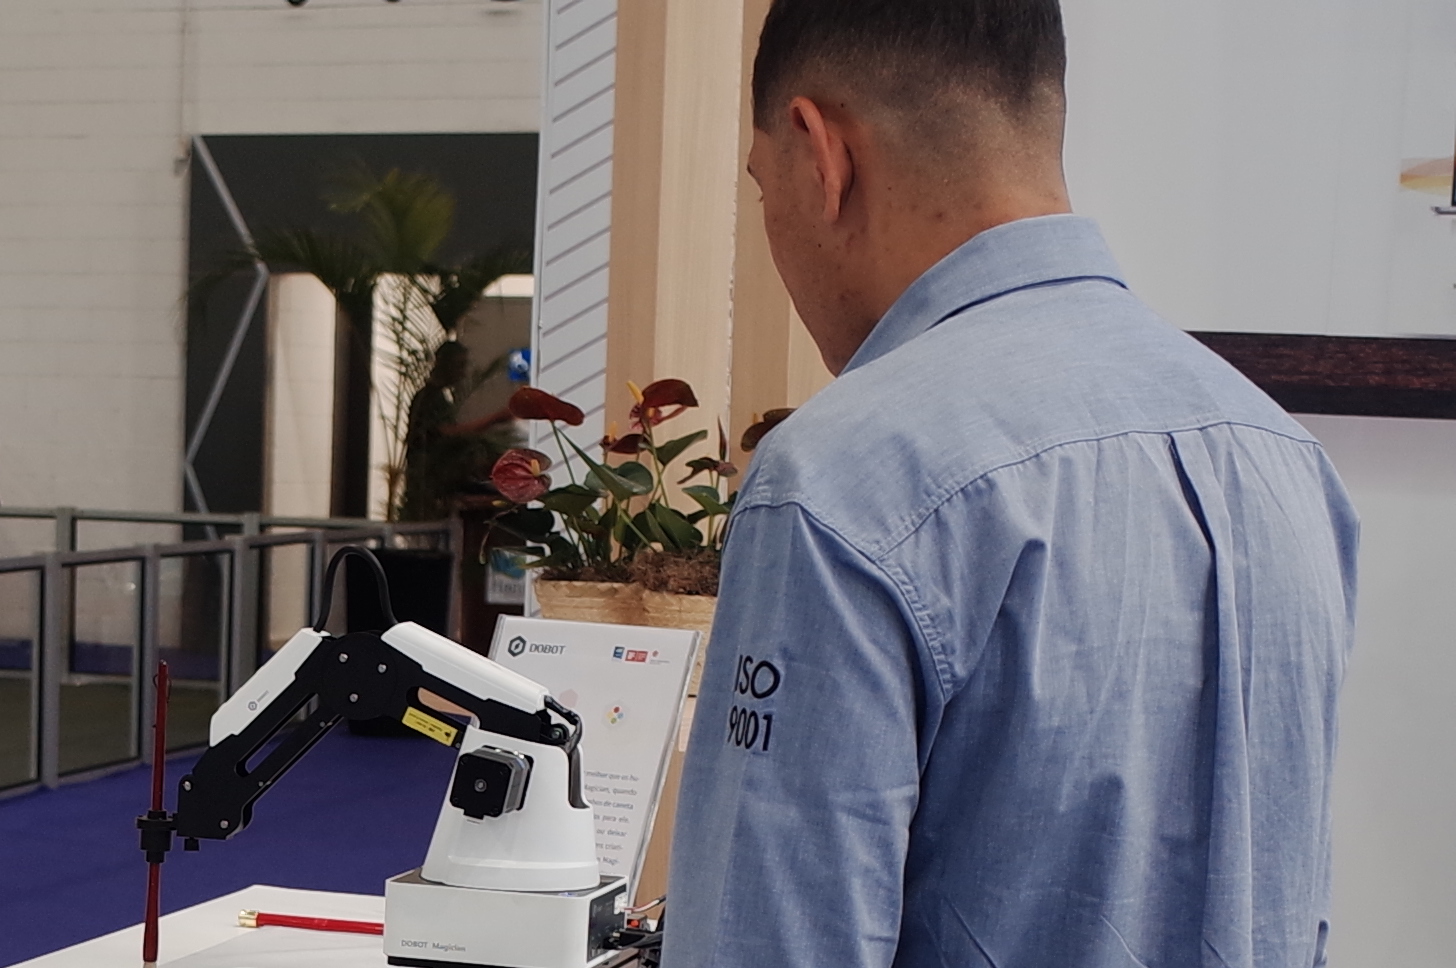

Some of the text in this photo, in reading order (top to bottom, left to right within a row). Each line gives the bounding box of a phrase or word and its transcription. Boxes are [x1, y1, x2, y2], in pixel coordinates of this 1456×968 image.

[529, 643, 566, 655] DOBOT
[734, 654, 781, 699] ISO
[727, 705, 773, 751] 9001
[401, 939, 466, 952] DOBOT Magician
